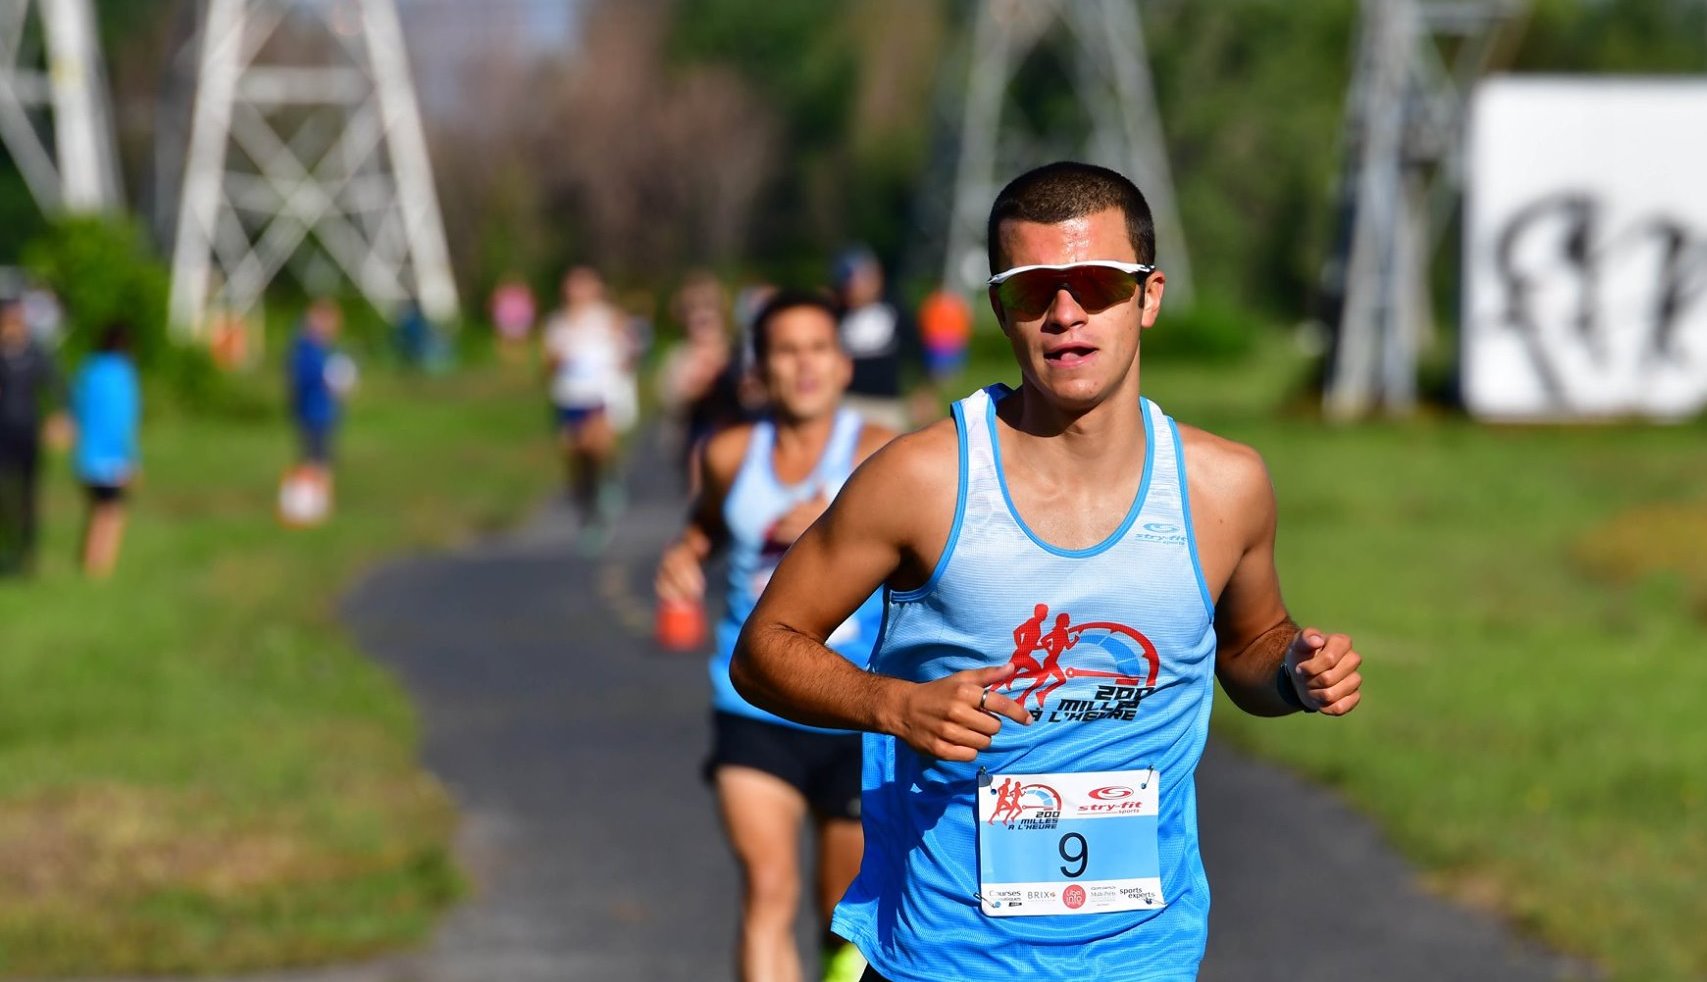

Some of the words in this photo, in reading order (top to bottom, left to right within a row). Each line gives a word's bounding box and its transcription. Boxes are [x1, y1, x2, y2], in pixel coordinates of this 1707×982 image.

[1094, 685, 1155, 701] 200
[1077, 801, 1143, 812] stry-fit
[1058, 832, 1089, 878] 9
[989, 889, 1021, 897] Curses
[1027, 891, 1050, 899] BRIX
[1119, 887, 1143, 895] sports
